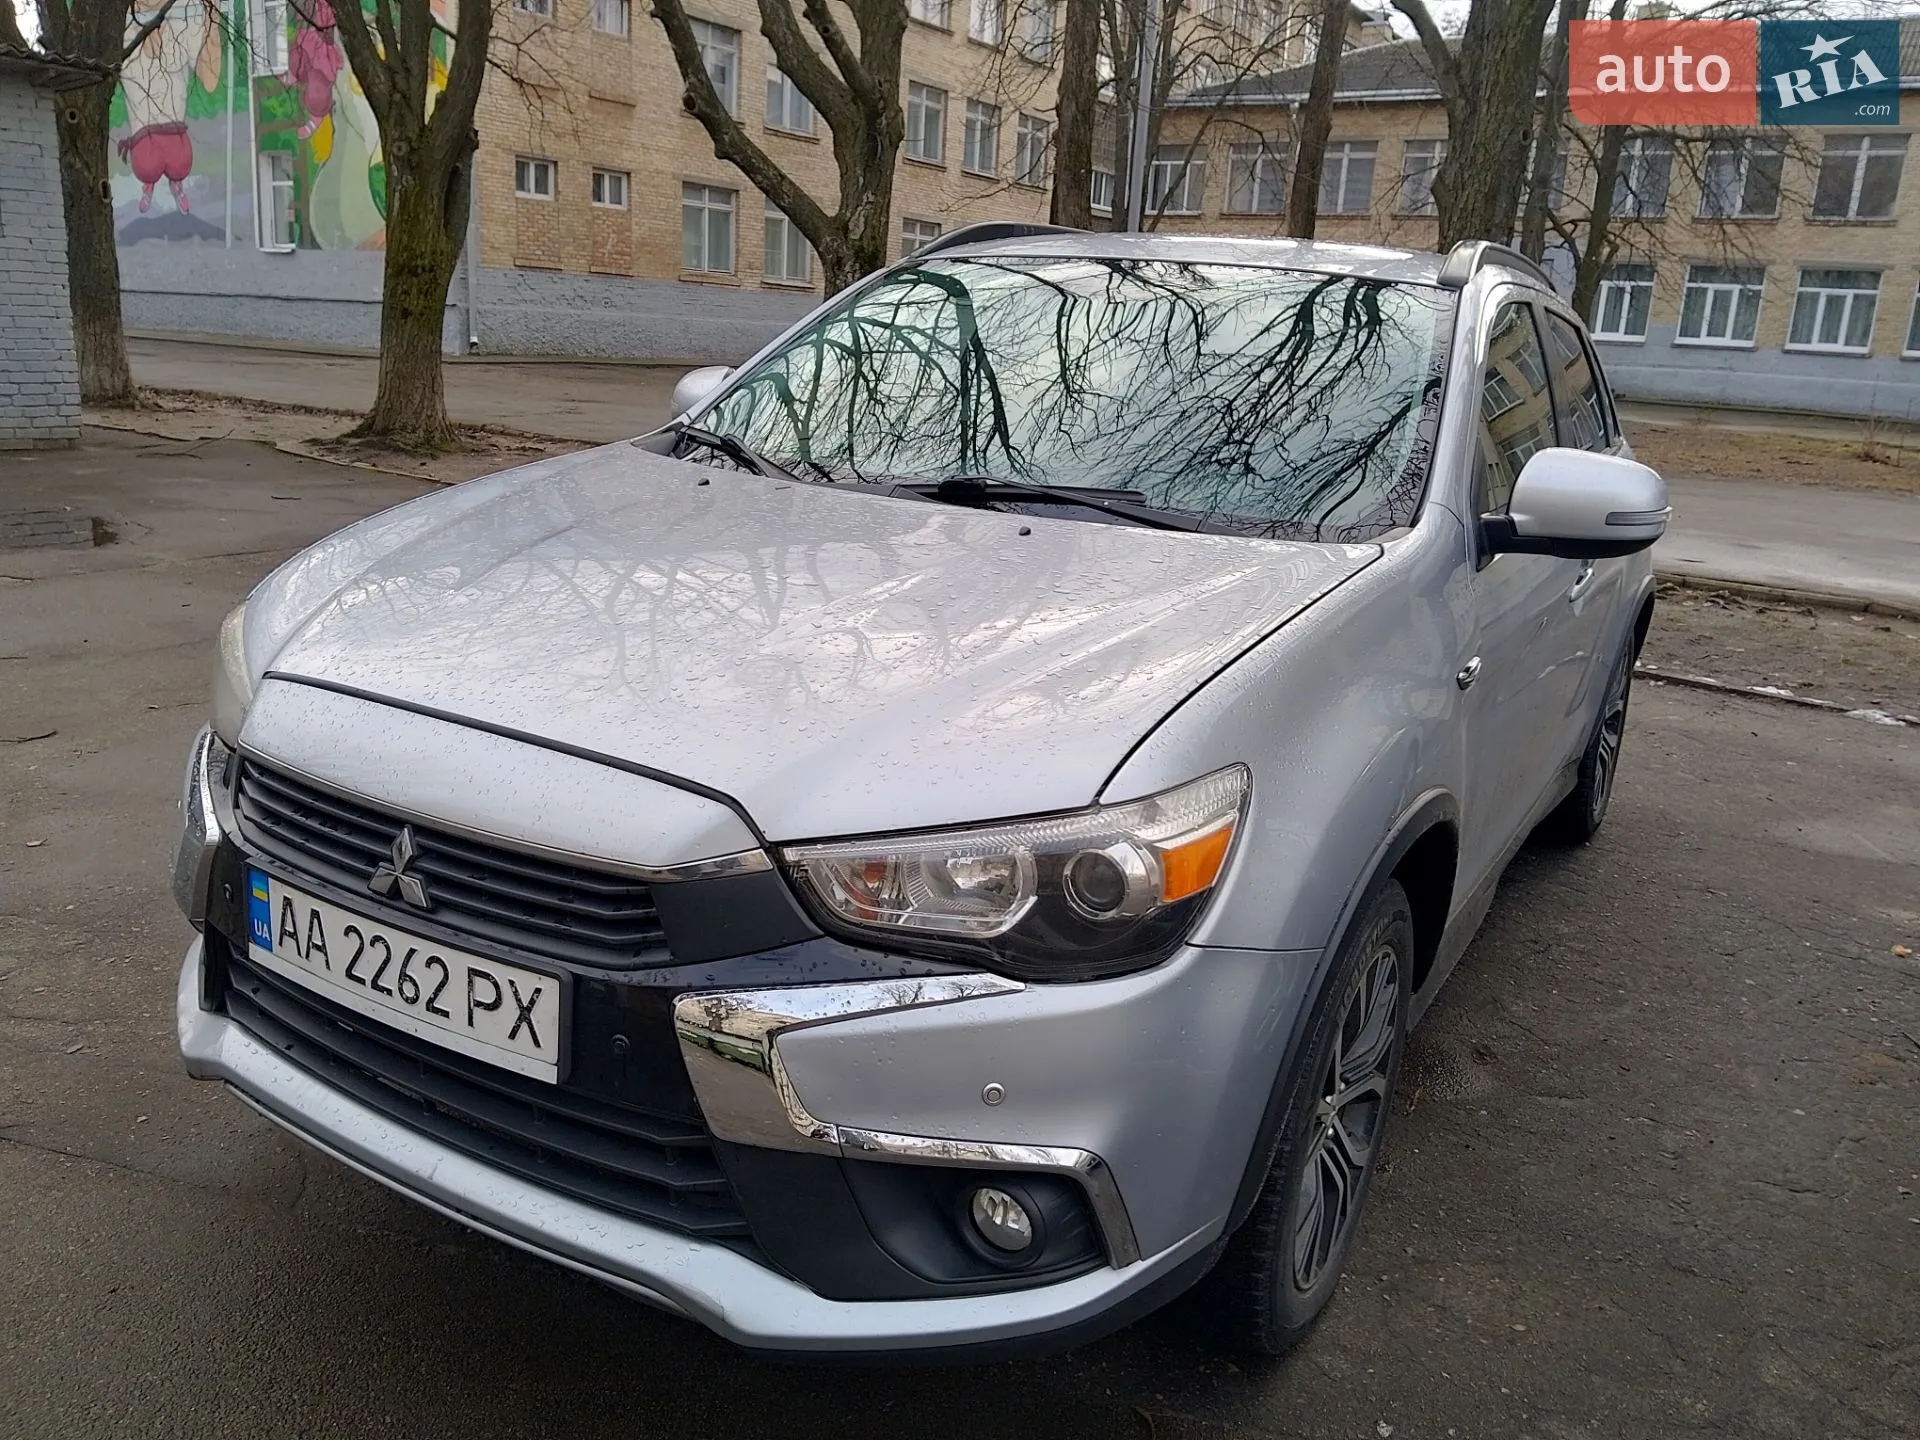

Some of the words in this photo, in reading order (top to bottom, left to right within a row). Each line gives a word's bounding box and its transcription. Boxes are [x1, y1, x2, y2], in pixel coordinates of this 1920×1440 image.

[254, 918, 270, 942] UA
[278, 895, 331, 971] AA
[344, 924, 451, 1020] 2262
[467, 966, 543, 1048] PX
